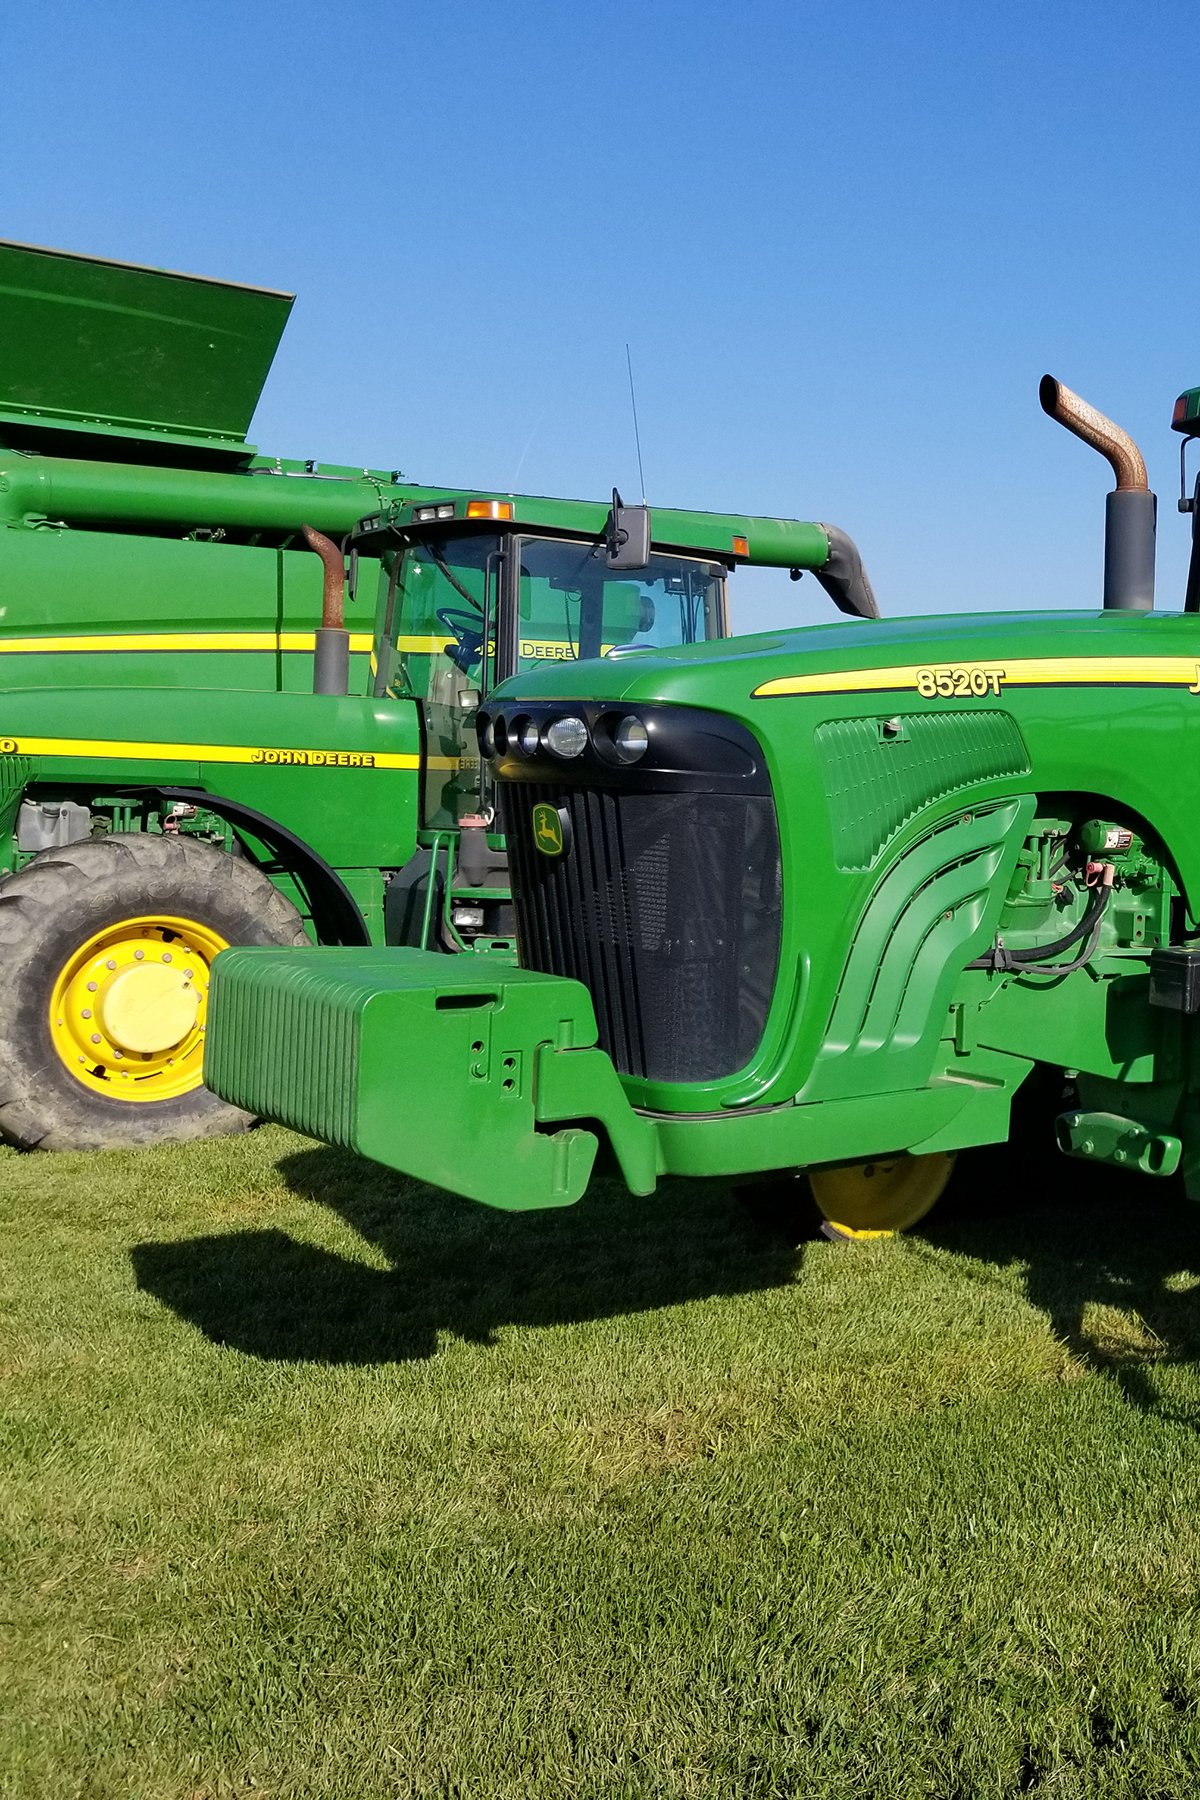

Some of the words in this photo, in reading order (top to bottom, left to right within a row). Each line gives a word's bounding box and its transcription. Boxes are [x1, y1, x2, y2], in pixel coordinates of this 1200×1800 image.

[522, 643, 575, 658] DEERE
[916, 668, 1006, 699] 8520T
[251, 749, 309, 765] JOHN
[311, 752, 376, 768] DEERE
